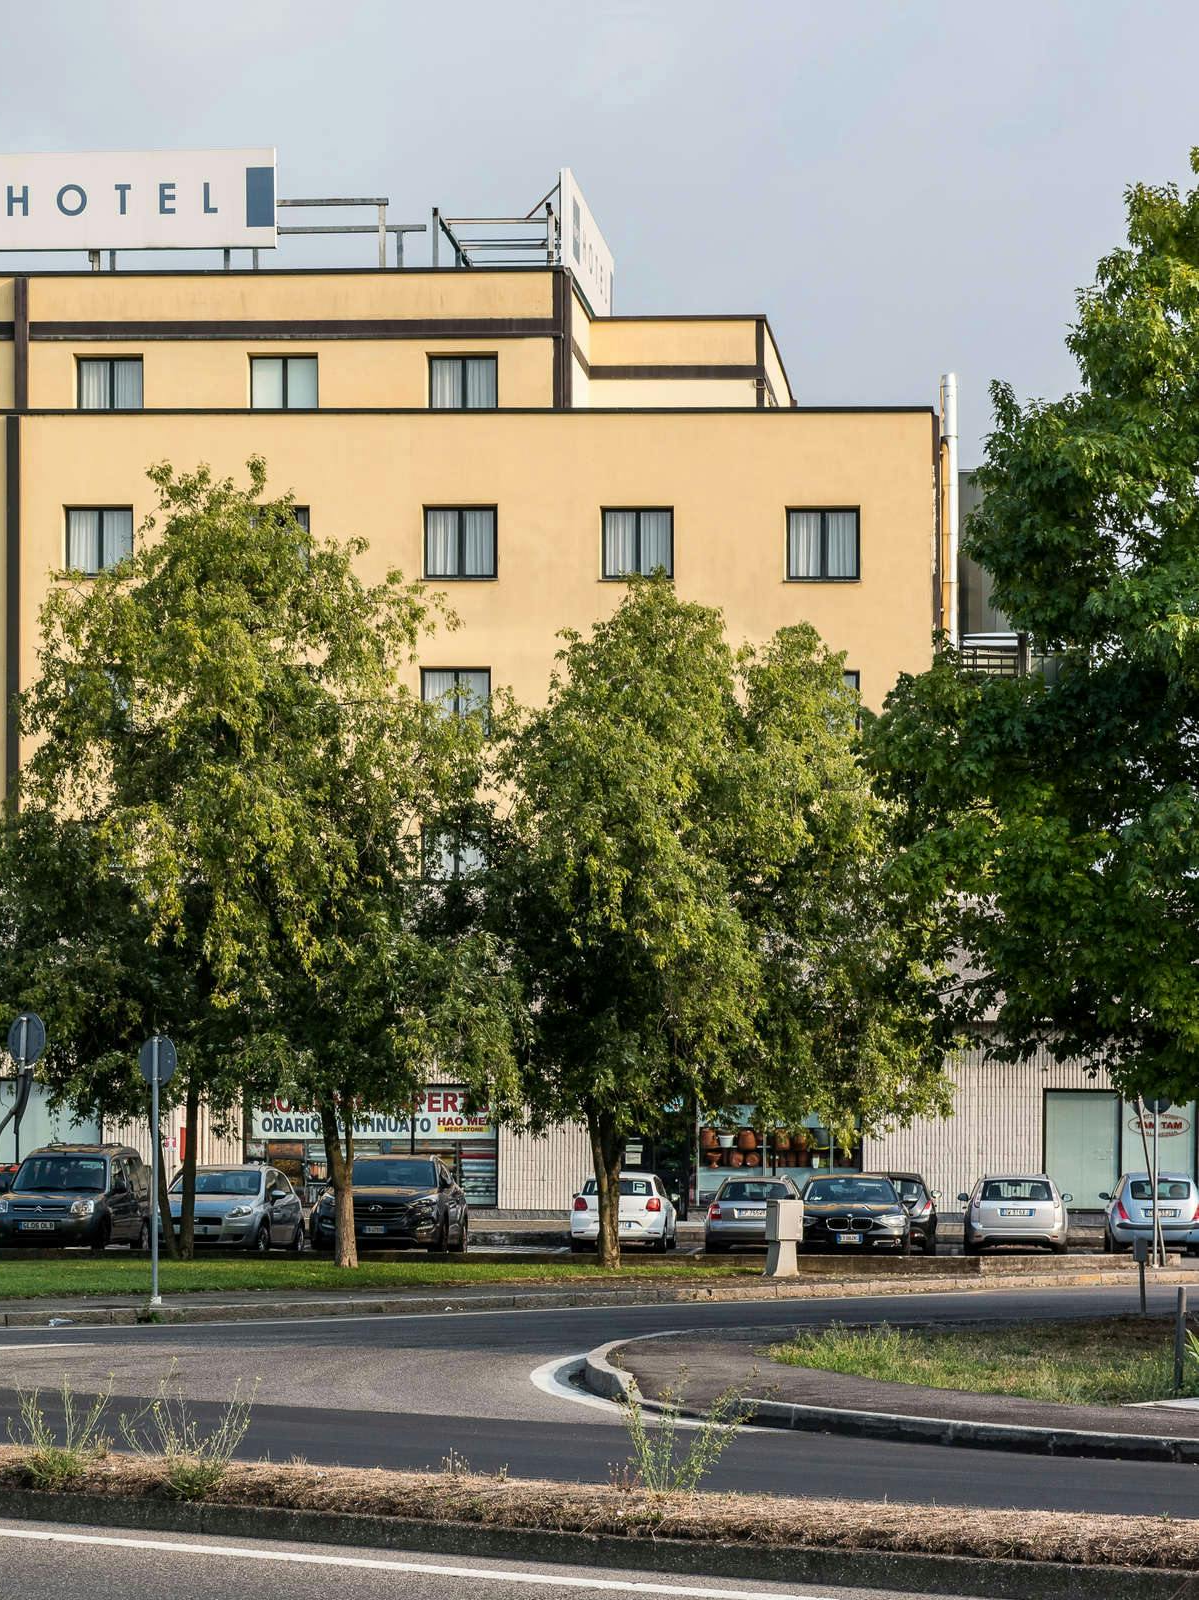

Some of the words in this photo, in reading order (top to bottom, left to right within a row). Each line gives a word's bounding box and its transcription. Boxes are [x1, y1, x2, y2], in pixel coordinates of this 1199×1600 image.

[6, 182, 219, 217] HOTEL
[262, 1117, 321, 1133] ORARIO
[327, 1117, 432, 1133] ONTINUATO
[437, 1117, 464, 1126] HAO
[1161, 1121, 1183, 1129] TAM
